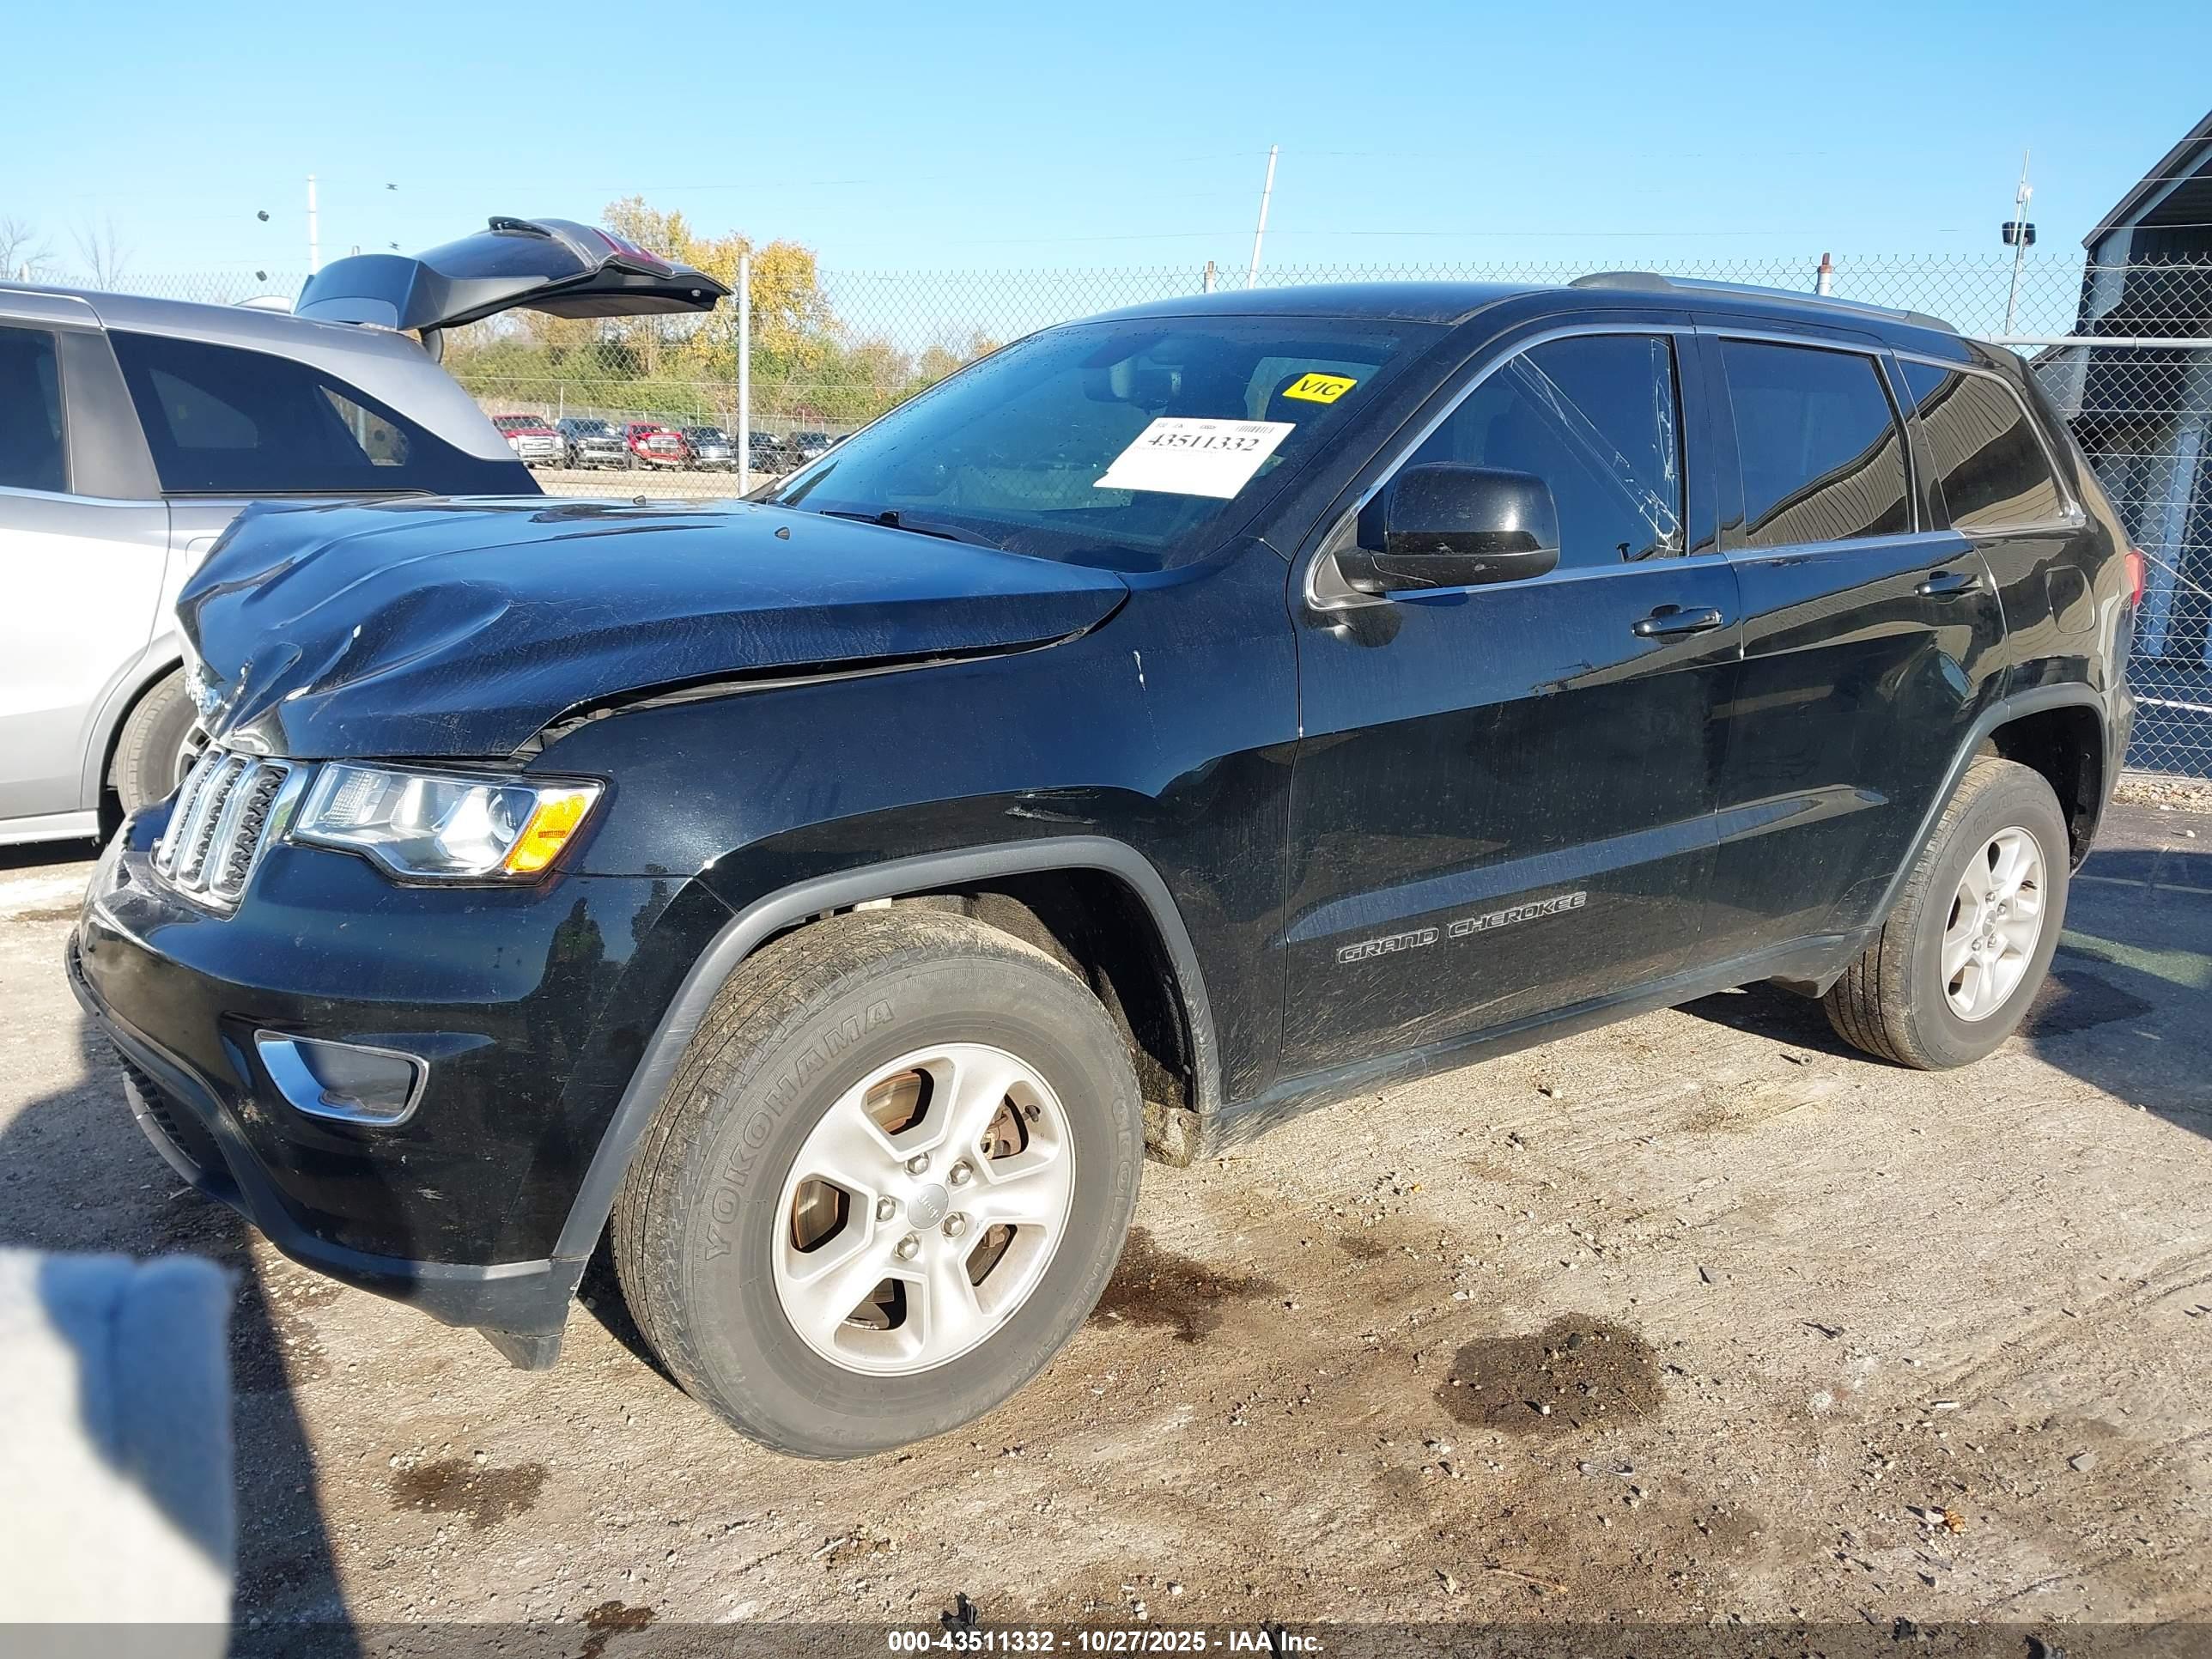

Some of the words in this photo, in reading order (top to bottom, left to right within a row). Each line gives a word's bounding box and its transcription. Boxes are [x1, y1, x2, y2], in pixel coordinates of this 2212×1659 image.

[1299, 379, 1344, 397] VIC
[1147, 432, 1261, 452] 43511332
[1337, 927, 1440, 963] GRAND
[1448, 890, 1587, 938] CHEROKEE
[704, 998, 895, 1262] YOKOHAMA
